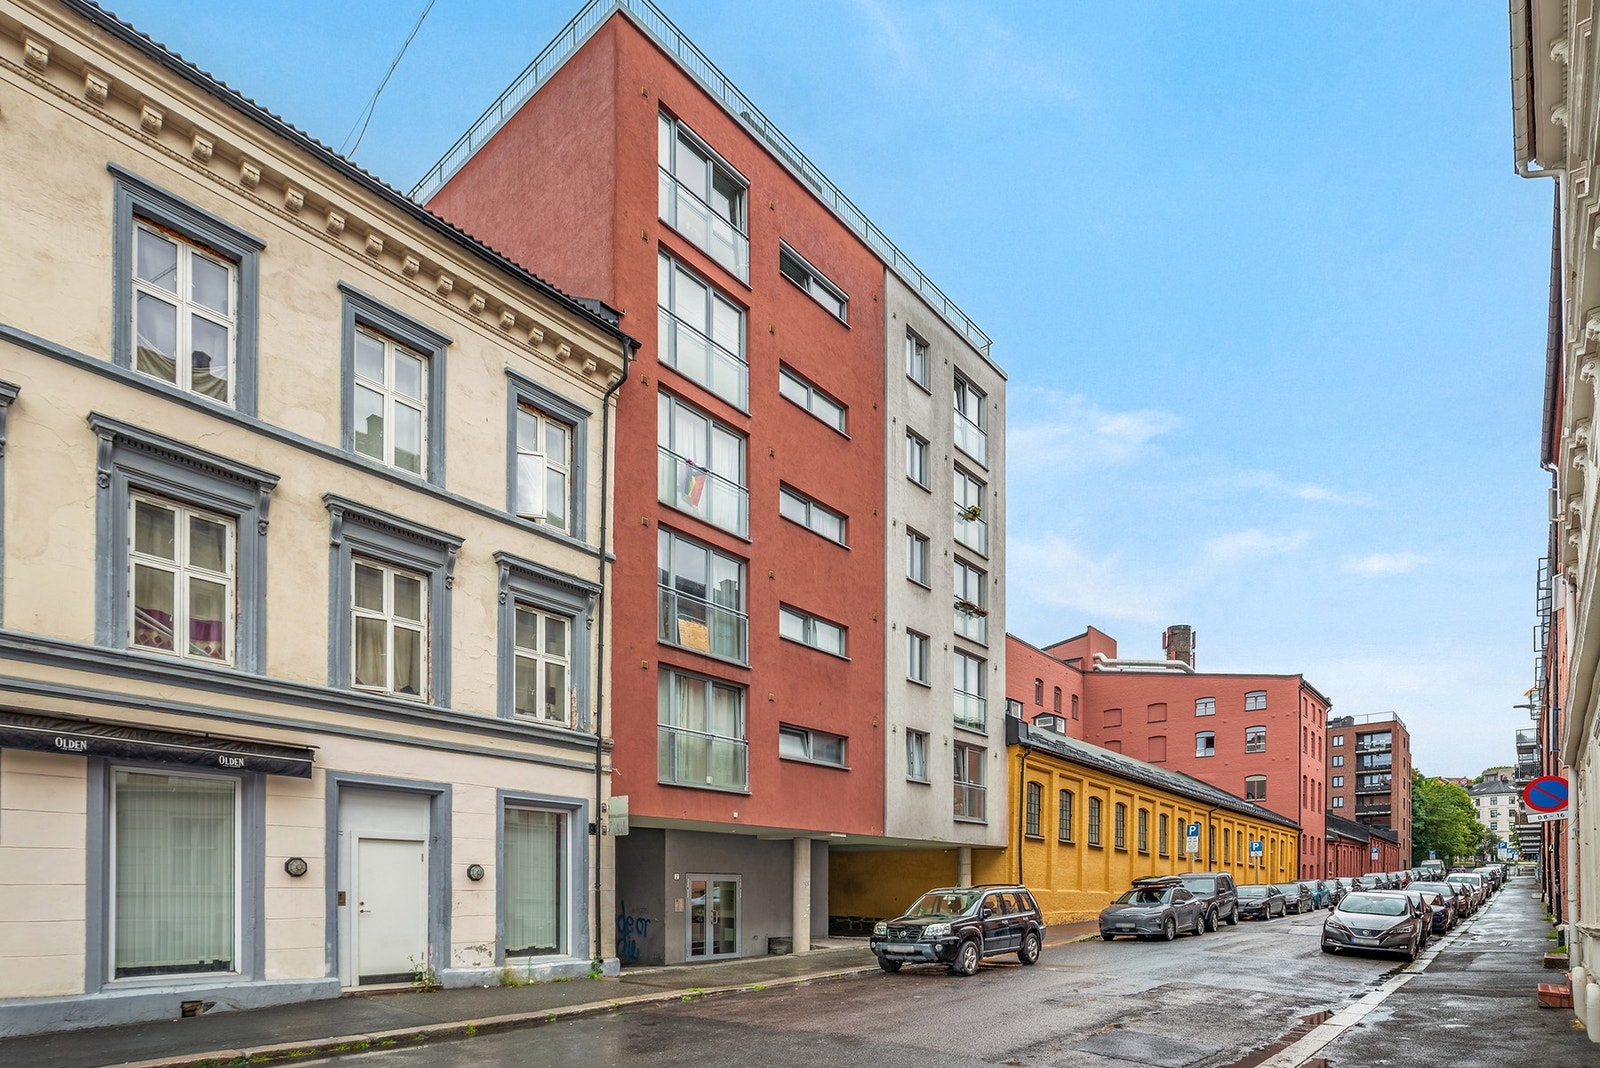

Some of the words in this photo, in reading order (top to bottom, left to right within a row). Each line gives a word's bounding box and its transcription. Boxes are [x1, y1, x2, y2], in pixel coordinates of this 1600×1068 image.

[55, 736, 87, 750] OLDEN
[218, 754, 245, 767] OLDEN
[1189, 826, 1197, 835] P
